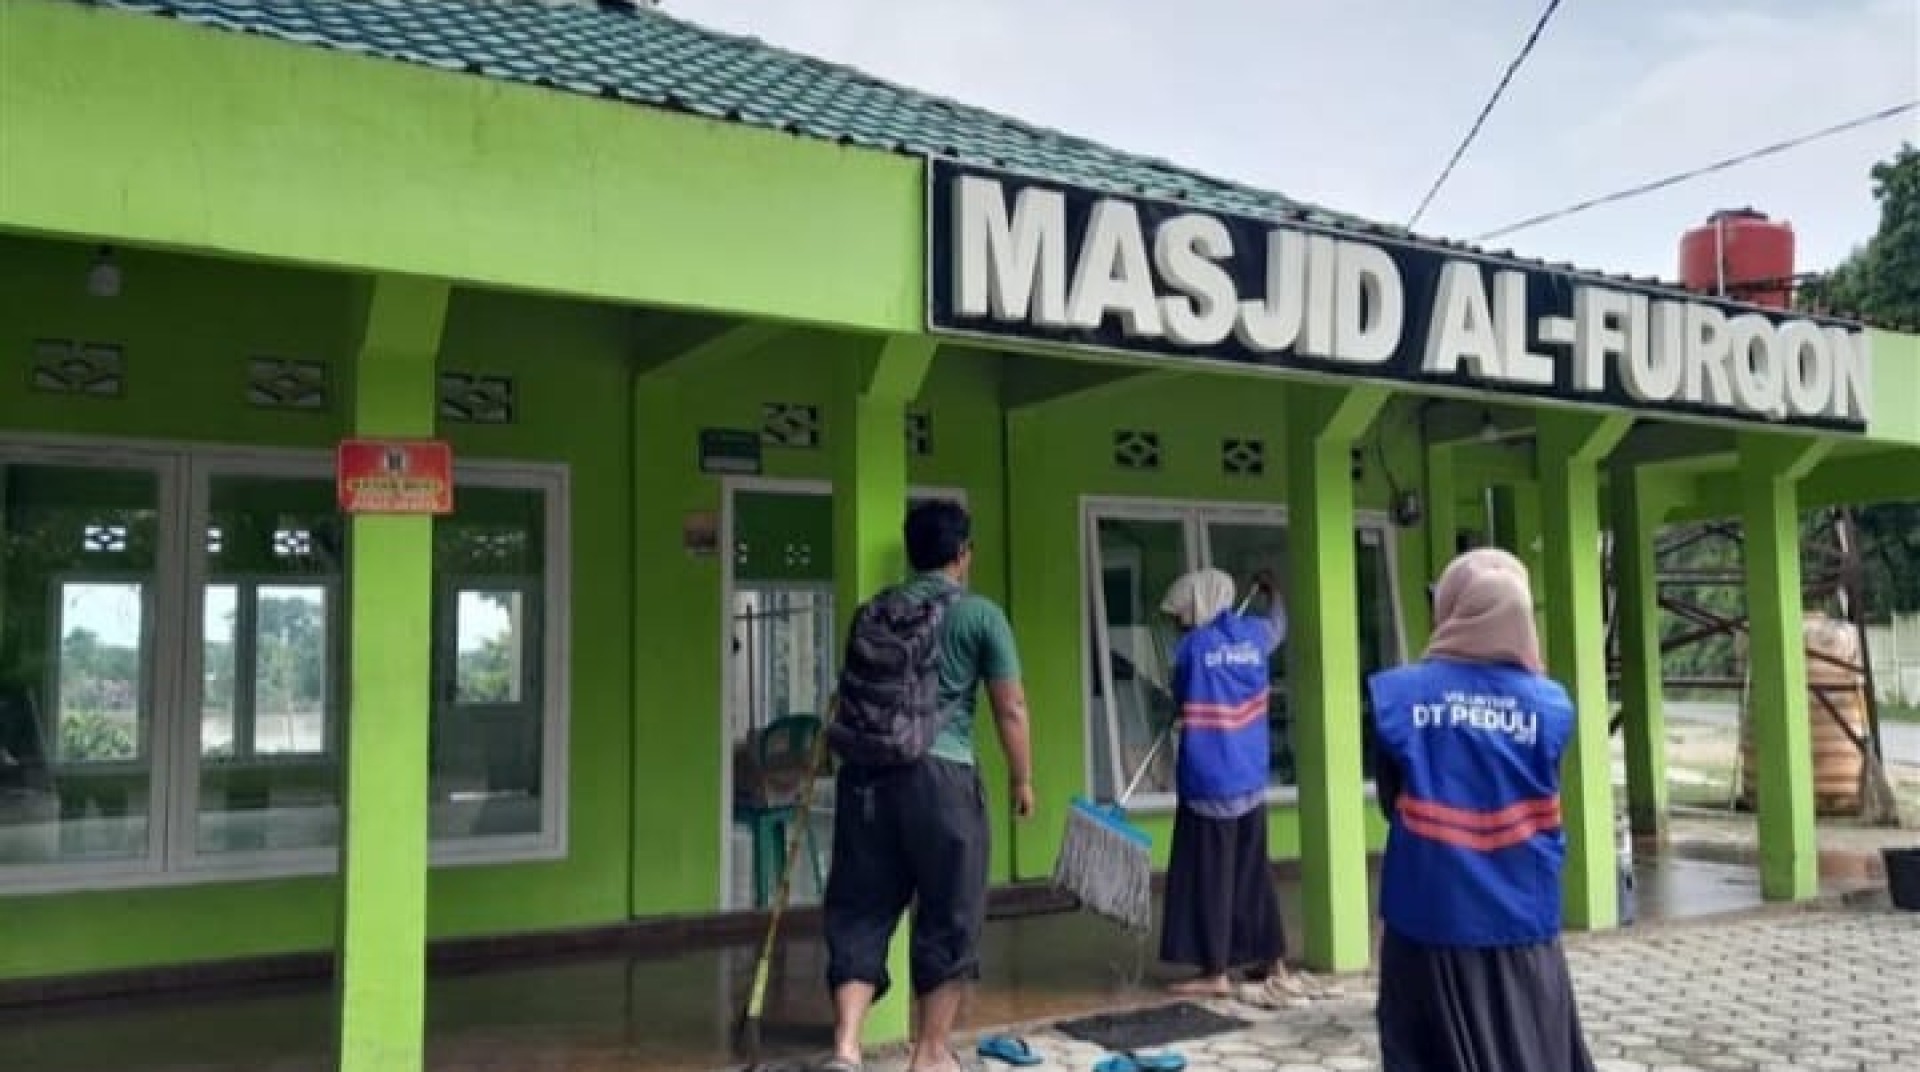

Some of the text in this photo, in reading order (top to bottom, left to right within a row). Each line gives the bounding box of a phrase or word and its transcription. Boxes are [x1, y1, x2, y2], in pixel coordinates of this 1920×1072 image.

[953, 174, 1874, 420] MASJID AL-FURQON
[1413, 703, 1538, 736] DT PEDULI
